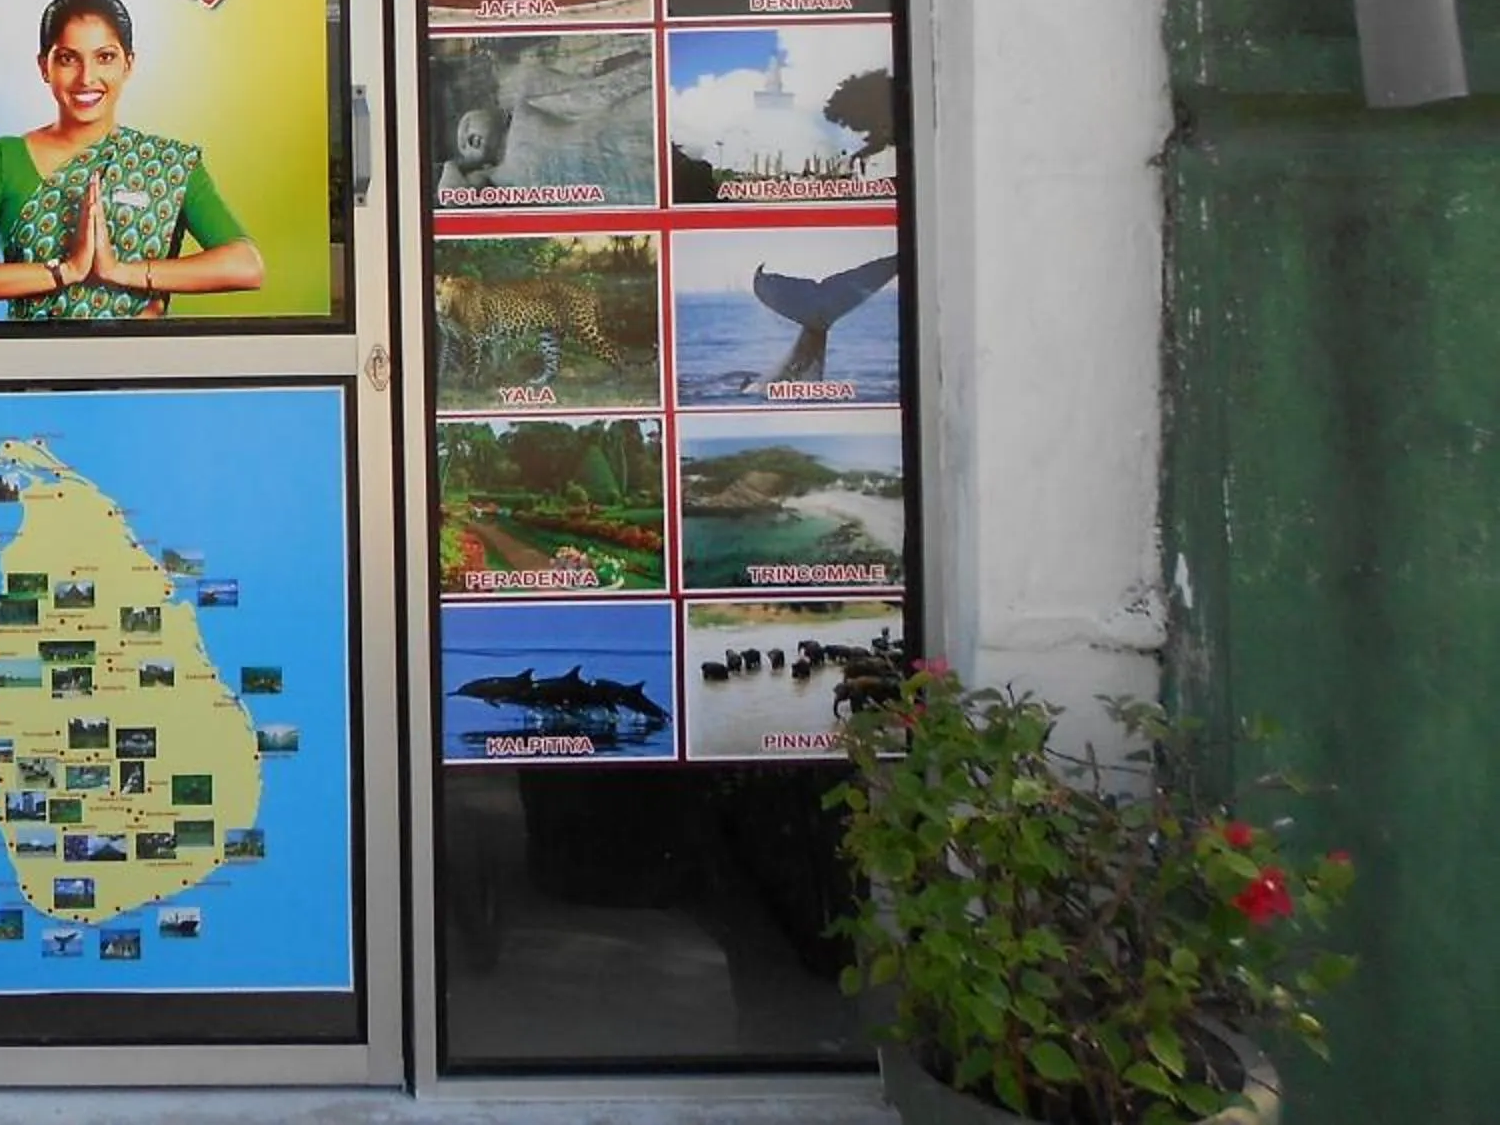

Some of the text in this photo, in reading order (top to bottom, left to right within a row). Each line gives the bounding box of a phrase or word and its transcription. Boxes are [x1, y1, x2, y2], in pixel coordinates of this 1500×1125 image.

[440, 186, 604, 204] POLONNARUWA
[717, 179, 896, 200] ANURADHAPURA
[500, 386, 556, 405] YALA
[768, 381, 855, 401] MIRISSA
[466, 569, 598, 589] PERADENIYA
[747, 564, 886, 583] TRINCOMALE
[486, 736, 595, 756] KALPITIYA
[762, 731, 840, 751] PINNAW
